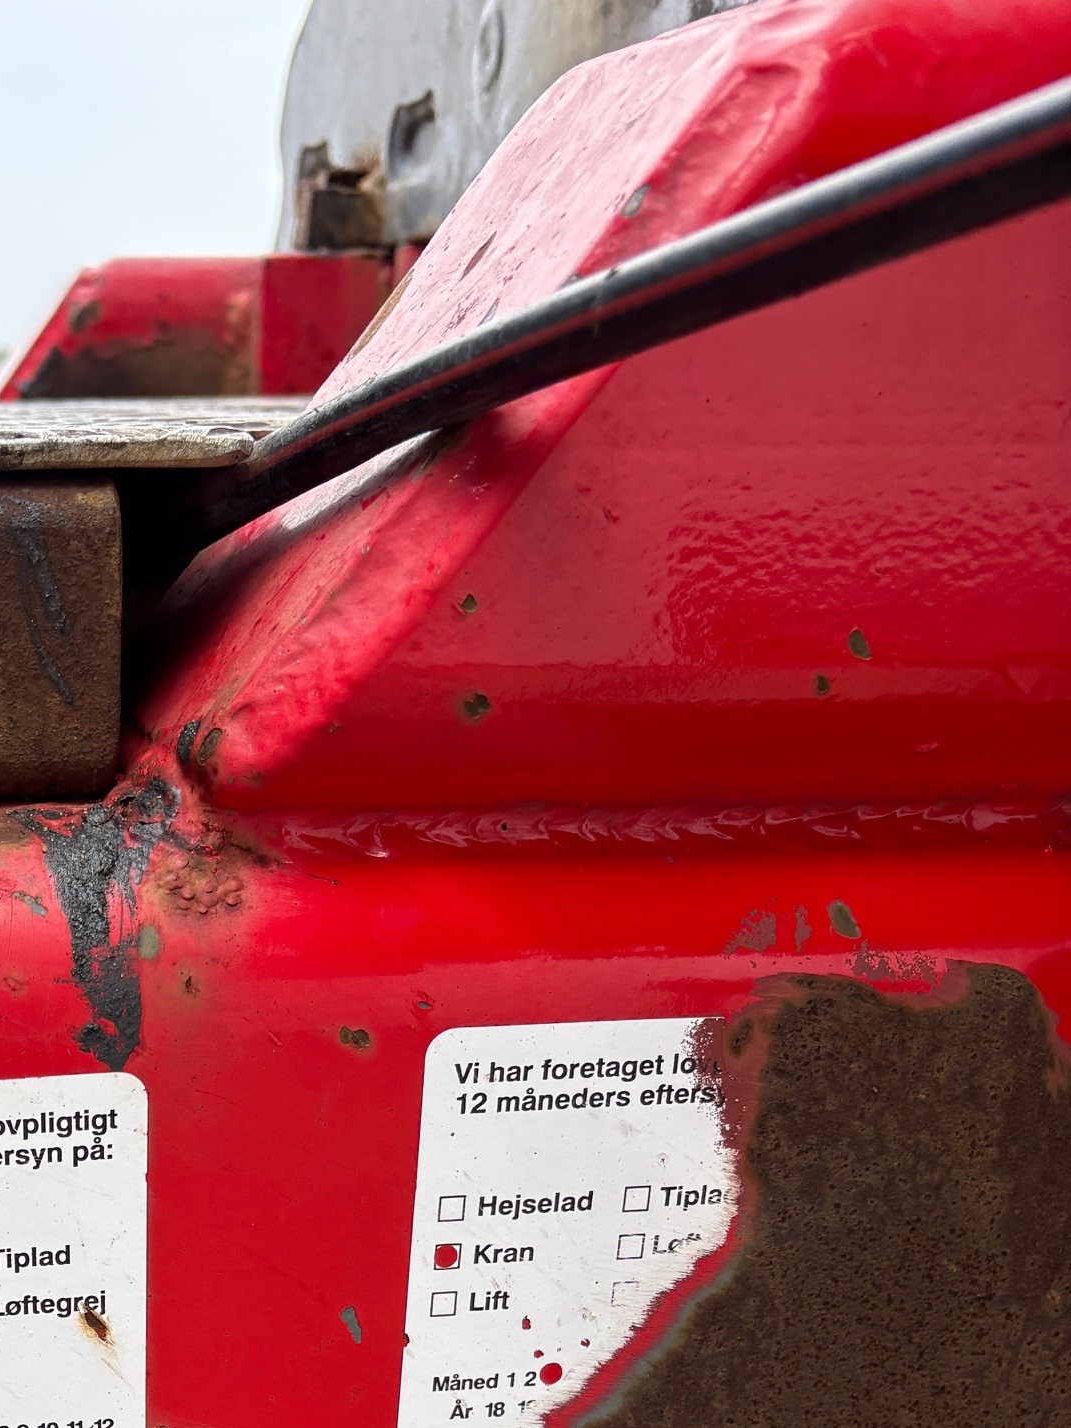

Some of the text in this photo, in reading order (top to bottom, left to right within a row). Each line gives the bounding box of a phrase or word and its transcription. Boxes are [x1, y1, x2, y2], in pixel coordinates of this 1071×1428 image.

[455, 1063, 479, 1084] Vi
[488, 1061, 533, 1083] har
[541, 1054, 664, 1082] foretaget
[456, 1093, 488, 1114] 12
[496, 1088, 631, 1113] måneders
[72, 1137, 114, 1168] på:
[477, 1191, 594, 1219] Hejselad
[473, 1243, 534, 1264] Kran
[469, 1291, 510, 1311] Lift
[432, 1371, 537, 1392] Måned 1 2
[449, 1399, 473, 1420] År
[485, 1402, 505, 1418] 18
